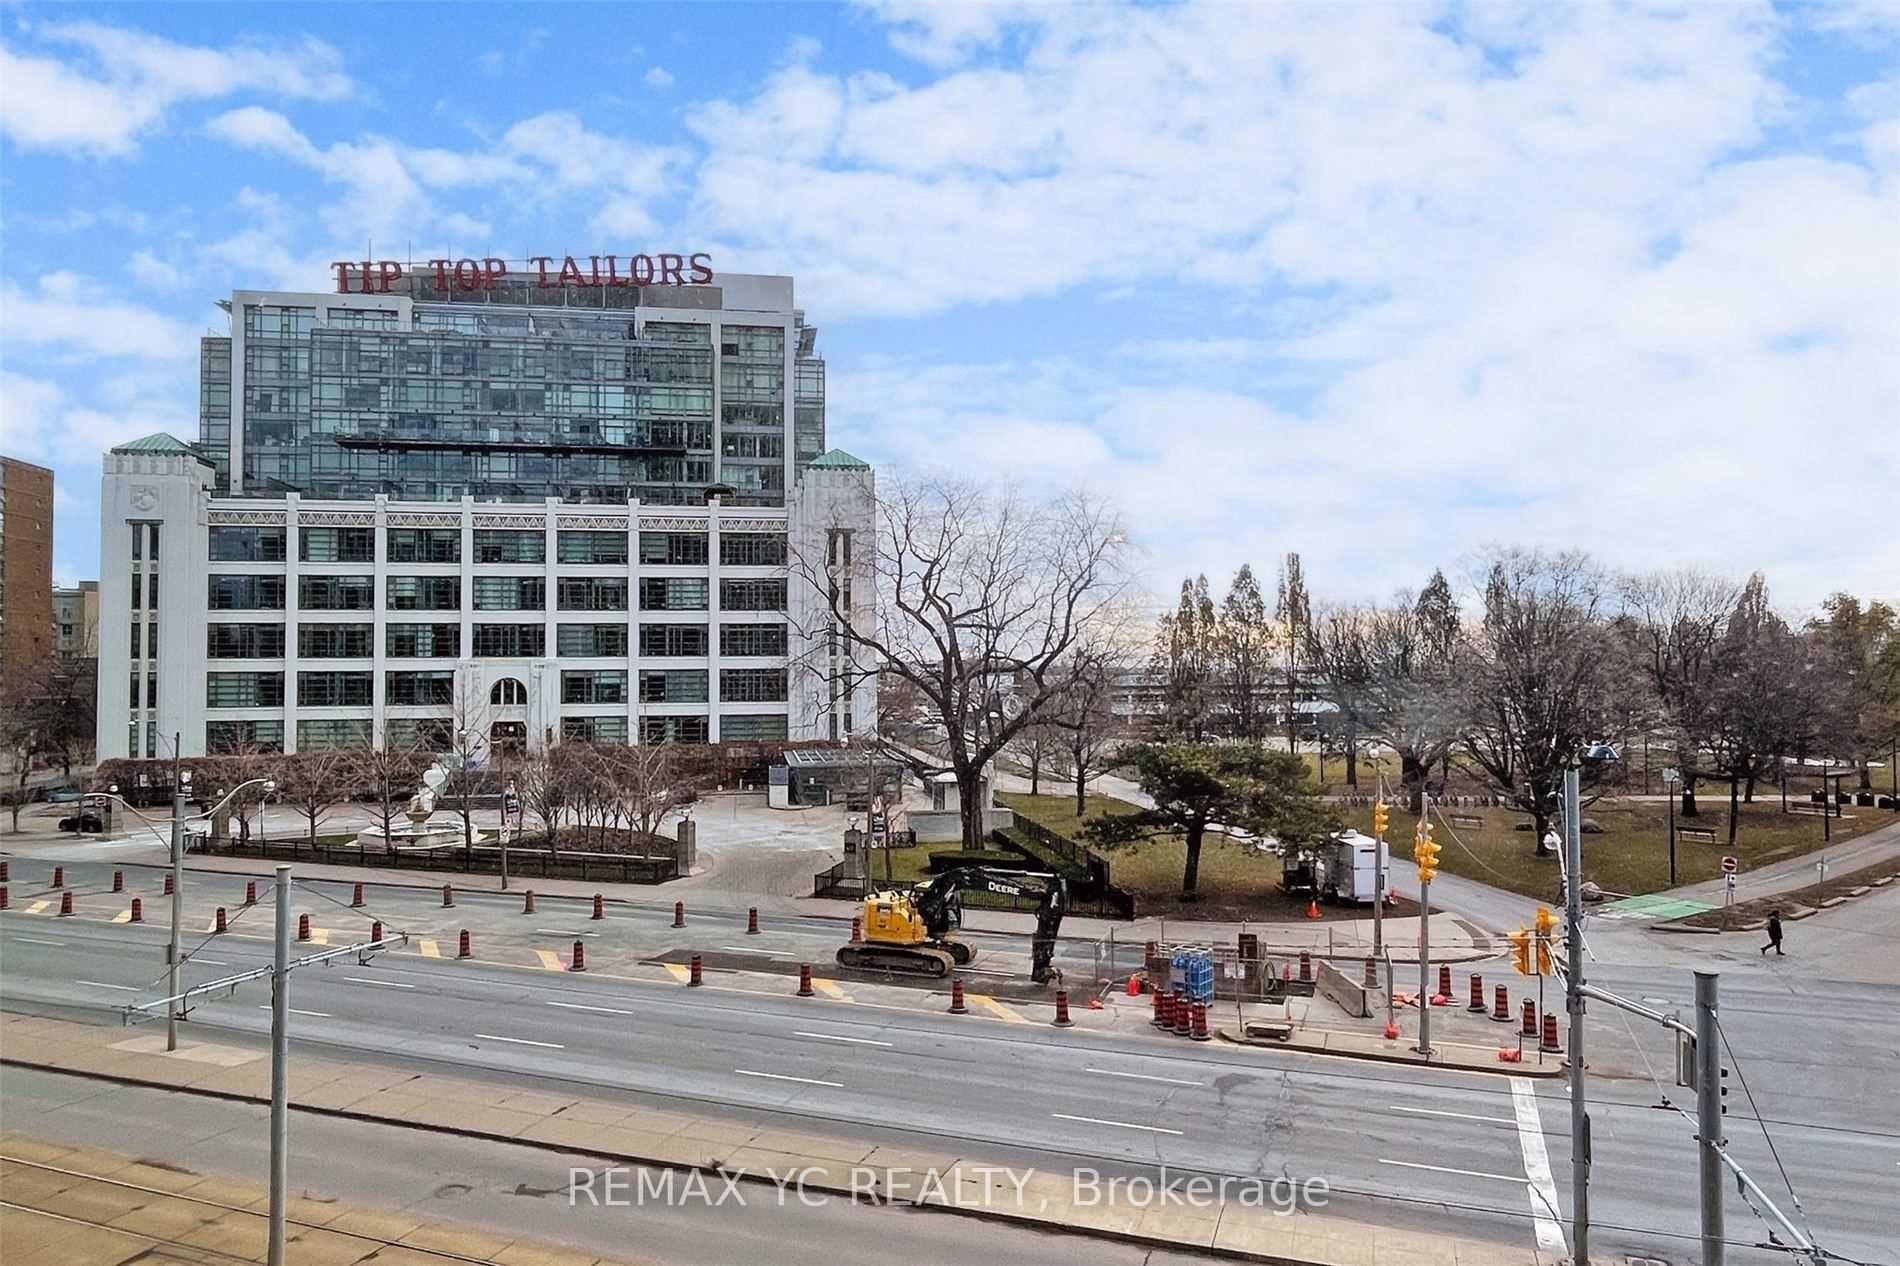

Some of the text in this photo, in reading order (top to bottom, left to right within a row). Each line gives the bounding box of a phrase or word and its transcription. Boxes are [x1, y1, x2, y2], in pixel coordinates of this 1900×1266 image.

[331, 252, 714, 293] TIP TOP TAILORS
[988, 881, 1020, 896] DEERE
